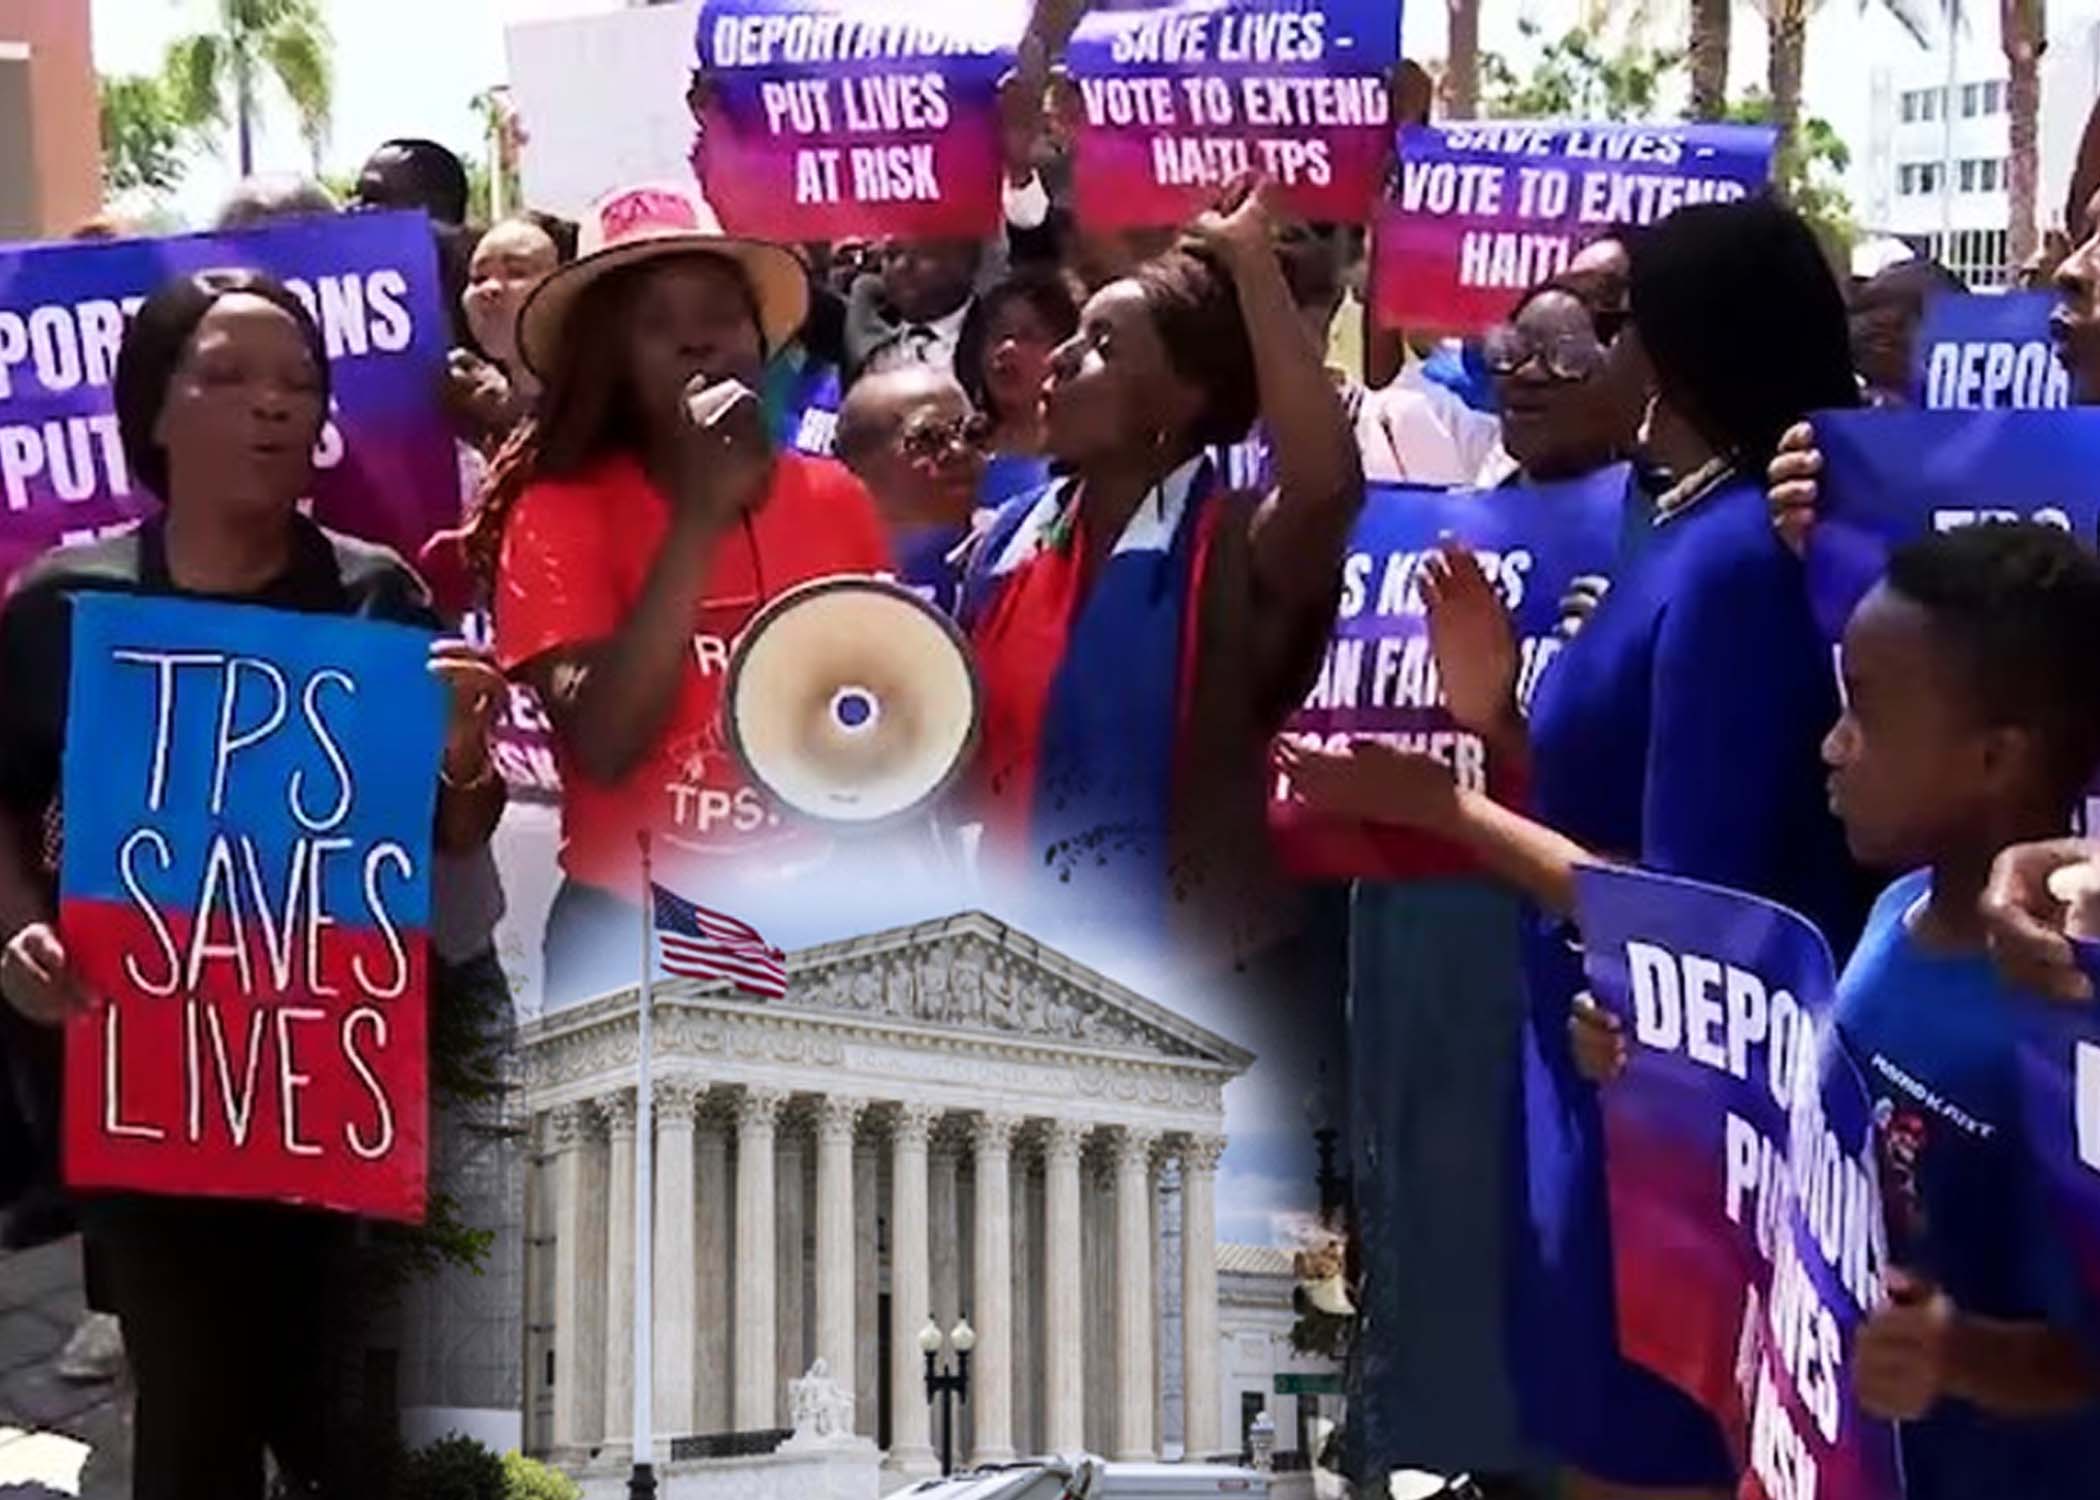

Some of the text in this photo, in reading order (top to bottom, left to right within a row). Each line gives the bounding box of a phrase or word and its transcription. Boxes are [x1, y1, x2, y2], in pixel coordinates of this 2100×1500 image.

[1112, 15, 1210, 63] SAVE
[1218, 11, 1326, 62] LIVES
[762, 72, 949, 135] PUT LIVES
[1079, 77, 1389, 126] VOTE TO EXTEND
[796, 144, 941, 204] AT RISK
[1152, 137, 1332, 186] HAITI TPS
[1565, 129, 1685, 166] LIVES
[1402, 161, 1505, 216] VOTE
[1517, 167, 1571, 220] TO
[1459, 231, 1571, 288] HAITI
[0, 412, 132, 510] PUT
[112, 648, 357, 832] TPS
[665, 781, 780, 832] TPS.
[120, 828, 414, 999] SAVES
[105, 1000, 396, 1161] LIVES
